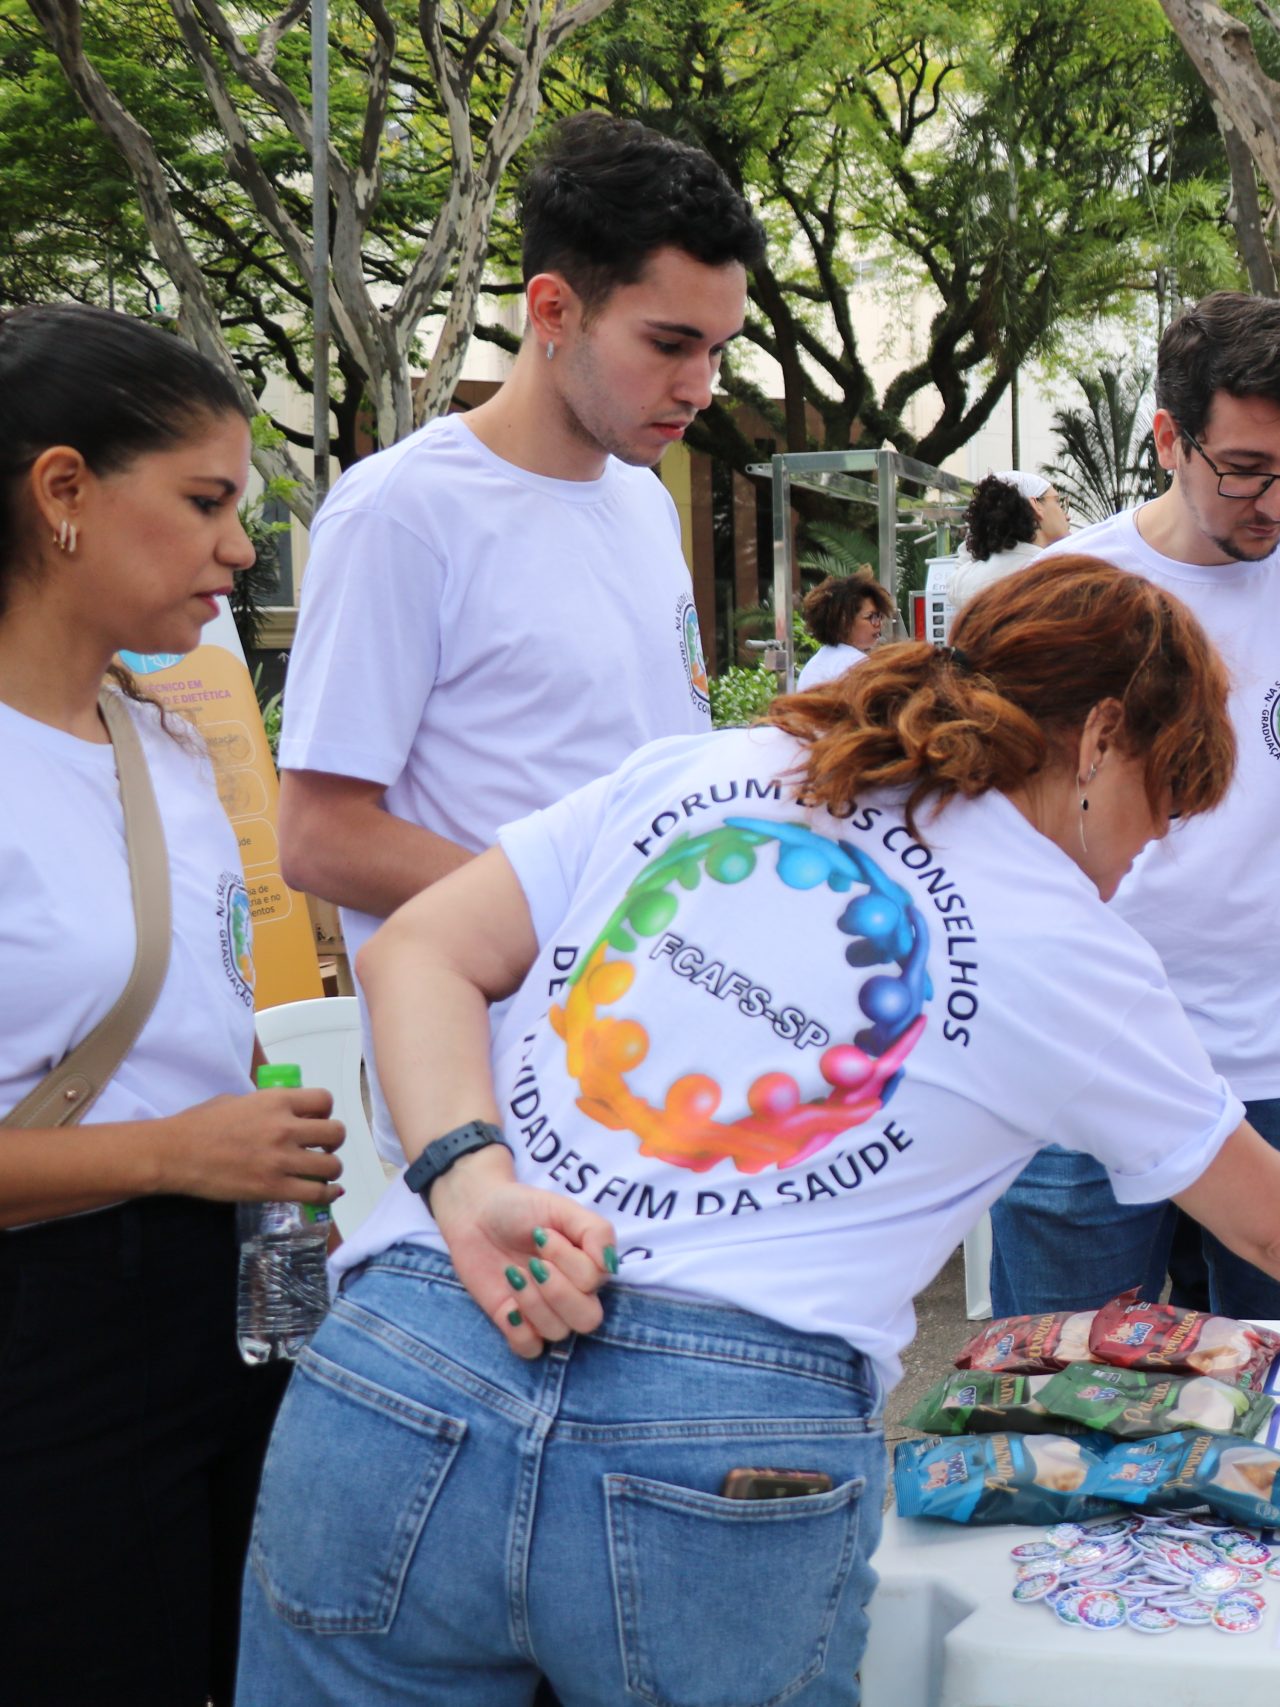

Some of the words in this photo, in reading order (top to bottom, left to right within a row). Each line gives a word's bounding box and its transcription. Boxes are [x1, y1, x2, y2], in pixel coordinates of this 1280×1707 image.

[1264, 688, 1278, 702] NA
[219, 929, 252, 1008] GRADUAÇÃO
[883, 826, 979, 1047] CONSELHOS
[650, 932, 830, 1050] FCAFS-SP
[593, 1176, 679, 1221] FIM
[696, 1188, 762, 1216] DA
[776, 1120, 914, 1206] SAÚDE
